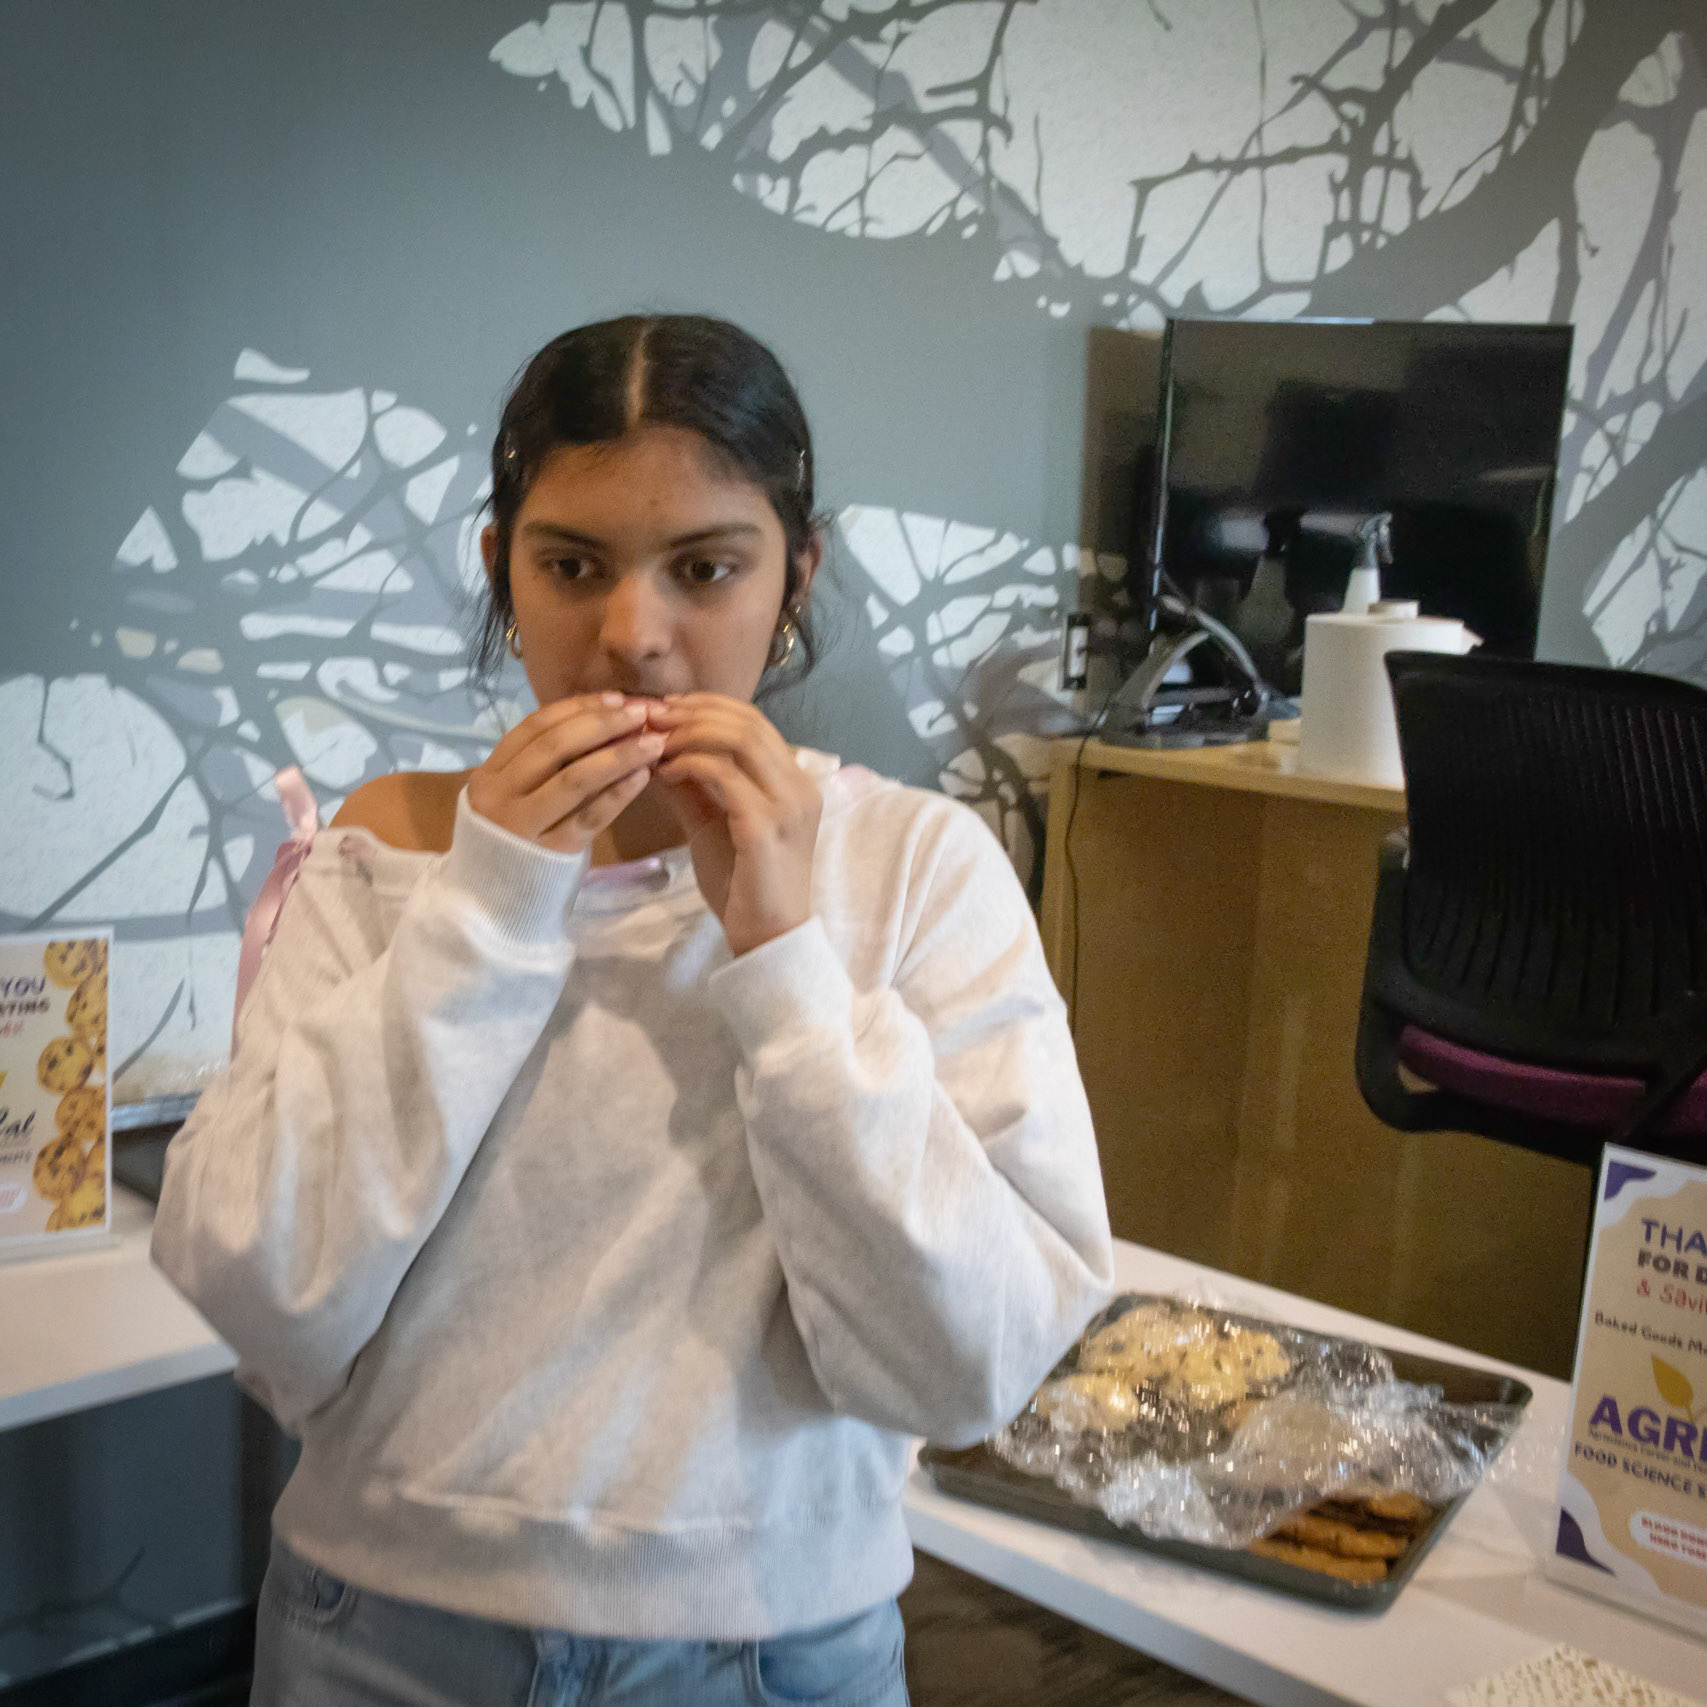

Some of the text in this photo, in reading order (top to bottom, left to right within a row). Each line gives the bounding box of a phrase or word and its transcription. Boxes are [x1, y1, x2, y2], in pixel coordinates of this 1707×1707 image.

[0, 976, 46, 998] YOU
[1641, 1218, 1707, 1256] THA
[1638, 1250, 1689, 1279] FOR
[1637, 1279, 1651, 1297] &
[1595, 1311, 1637, 1335] Baked
[1641, 1325, 1682, 1349] Goods
[1575, 1441, 1617, 1468] FOOD
[1623, 1458, 1692, 1494] SCIENCE
